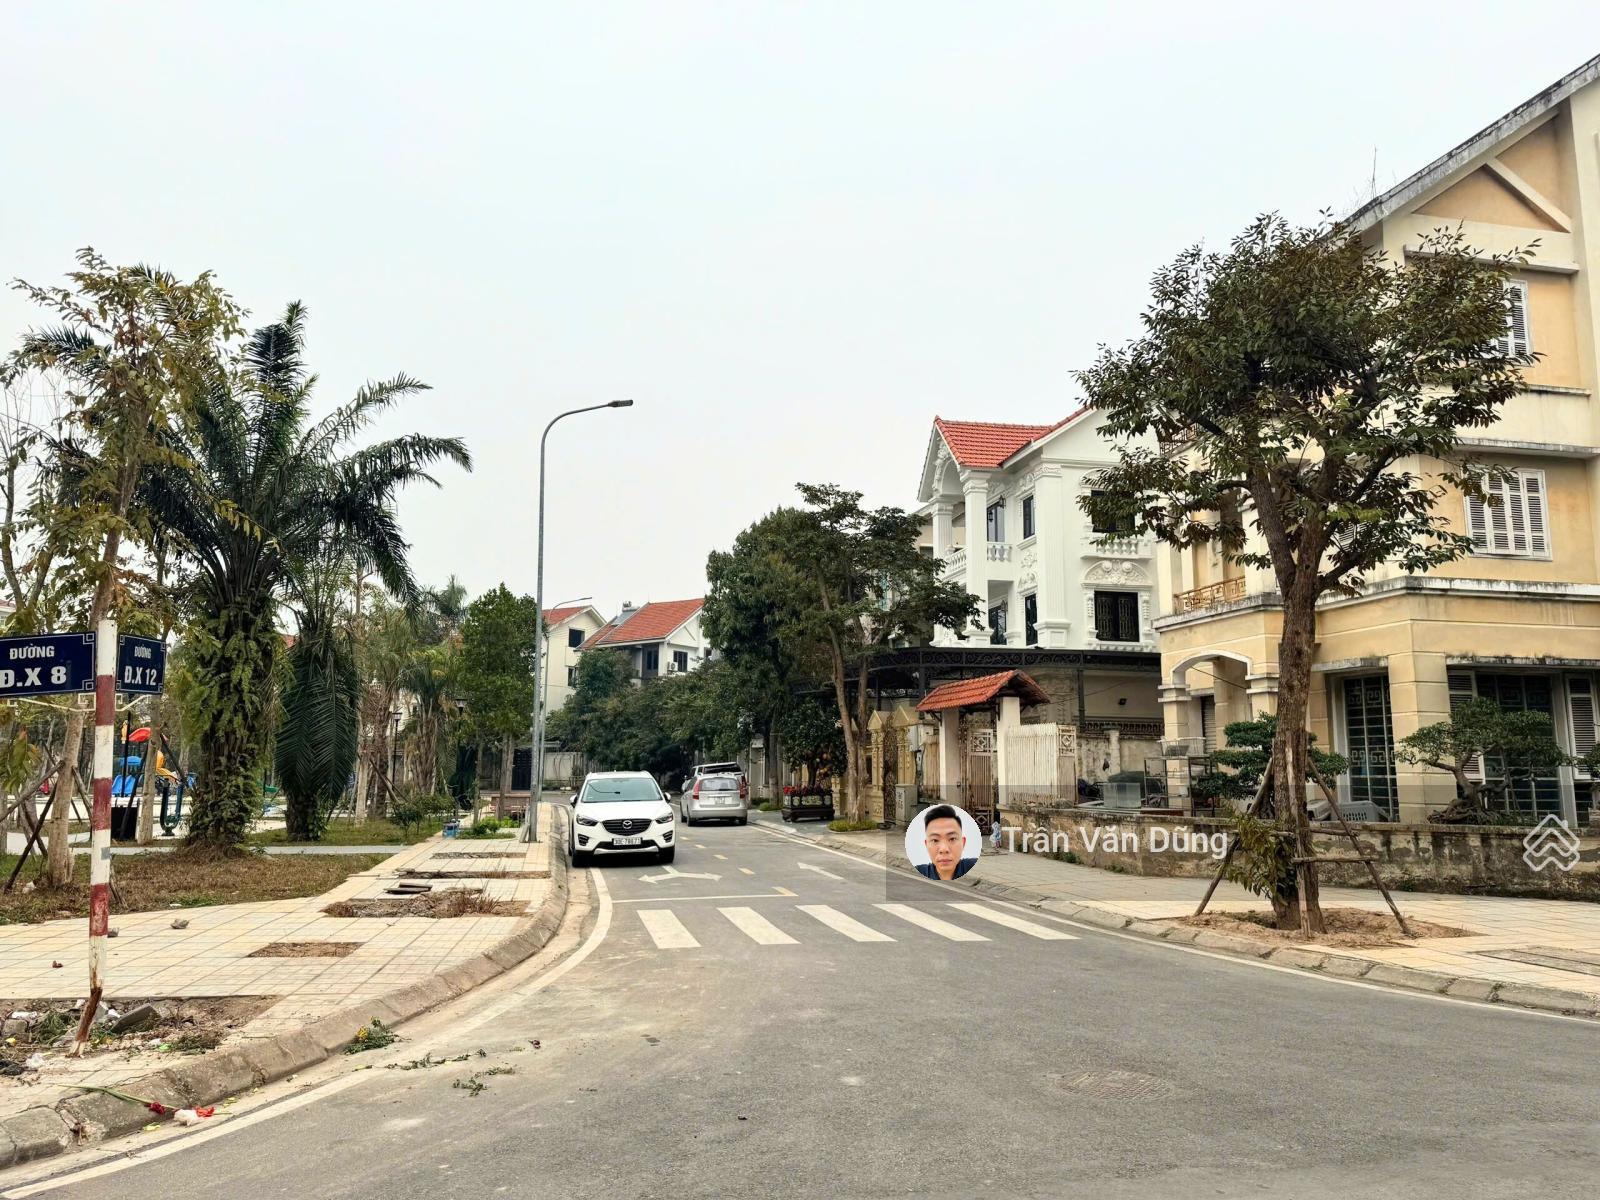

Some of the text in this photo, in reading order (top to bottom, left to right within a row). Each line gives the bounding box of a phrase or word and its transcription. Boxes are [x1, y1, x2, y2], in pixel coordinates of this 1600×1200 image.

[9, 643, 55, 660] ĐƯỜNG
[0, 665, 67, 688] Đ.X 8
[124, 665, 157, 686] Đ.X 12
